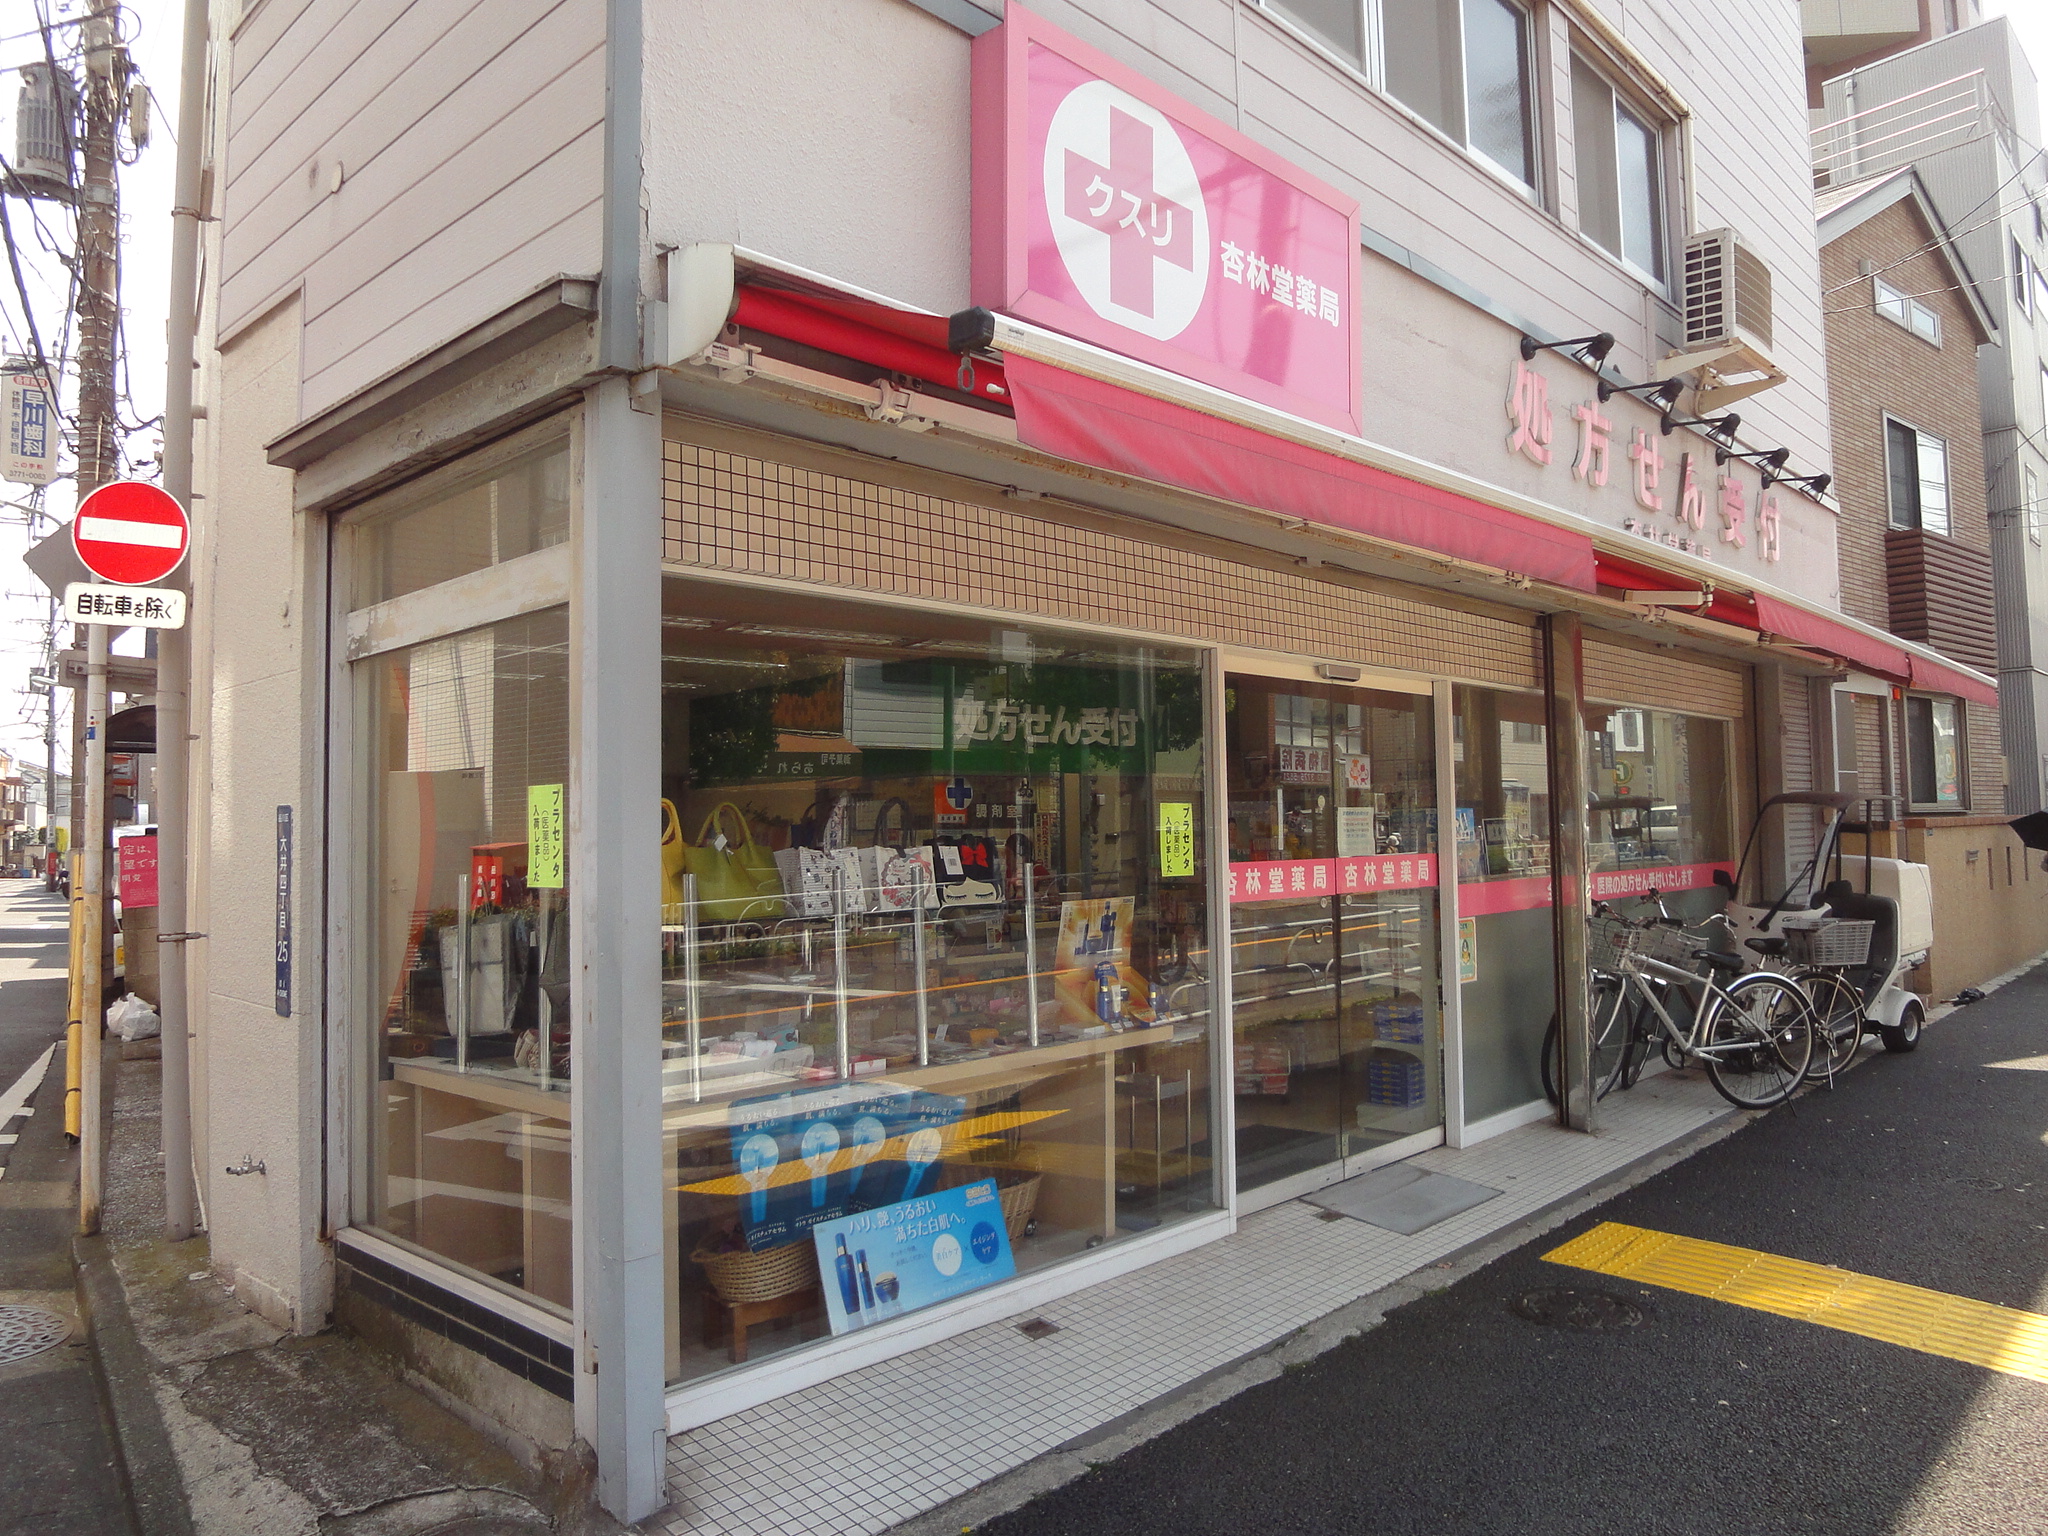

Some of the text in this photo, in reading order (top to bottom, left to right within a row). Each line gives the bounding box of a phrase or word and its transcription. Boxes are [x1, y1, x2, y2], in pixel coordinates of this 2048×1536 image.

[1085, 175, 1173, 247] クスリ
[1220, 240, 1340, 328] 杏林堂薬局
[23, 391, 46, 457] 早川歯科
[1505, 359, 1782, 563] 処方せん受付
[77, 593, 173, 620] 自転車を除く
[953, 698, 1139, 748] 処方せん受付
[533, 805, 541, 883] 入荷しました
[552, 790, 560, 879] プラセンタ
[123, 859, 158, 871] 望です
[279, 836, 288, 929] 大井四丁目
[1227, 865, 1327, 896] 杏林堂薬局
[1345, 859, 1429, 888] 杏林堂薬局
[277, 940, 288, 963] 25
[850, 1200, 938, 1234] ハリ、艶、うるおい
[896, 1212, 967, 1244] 満ちた白肌へ。
